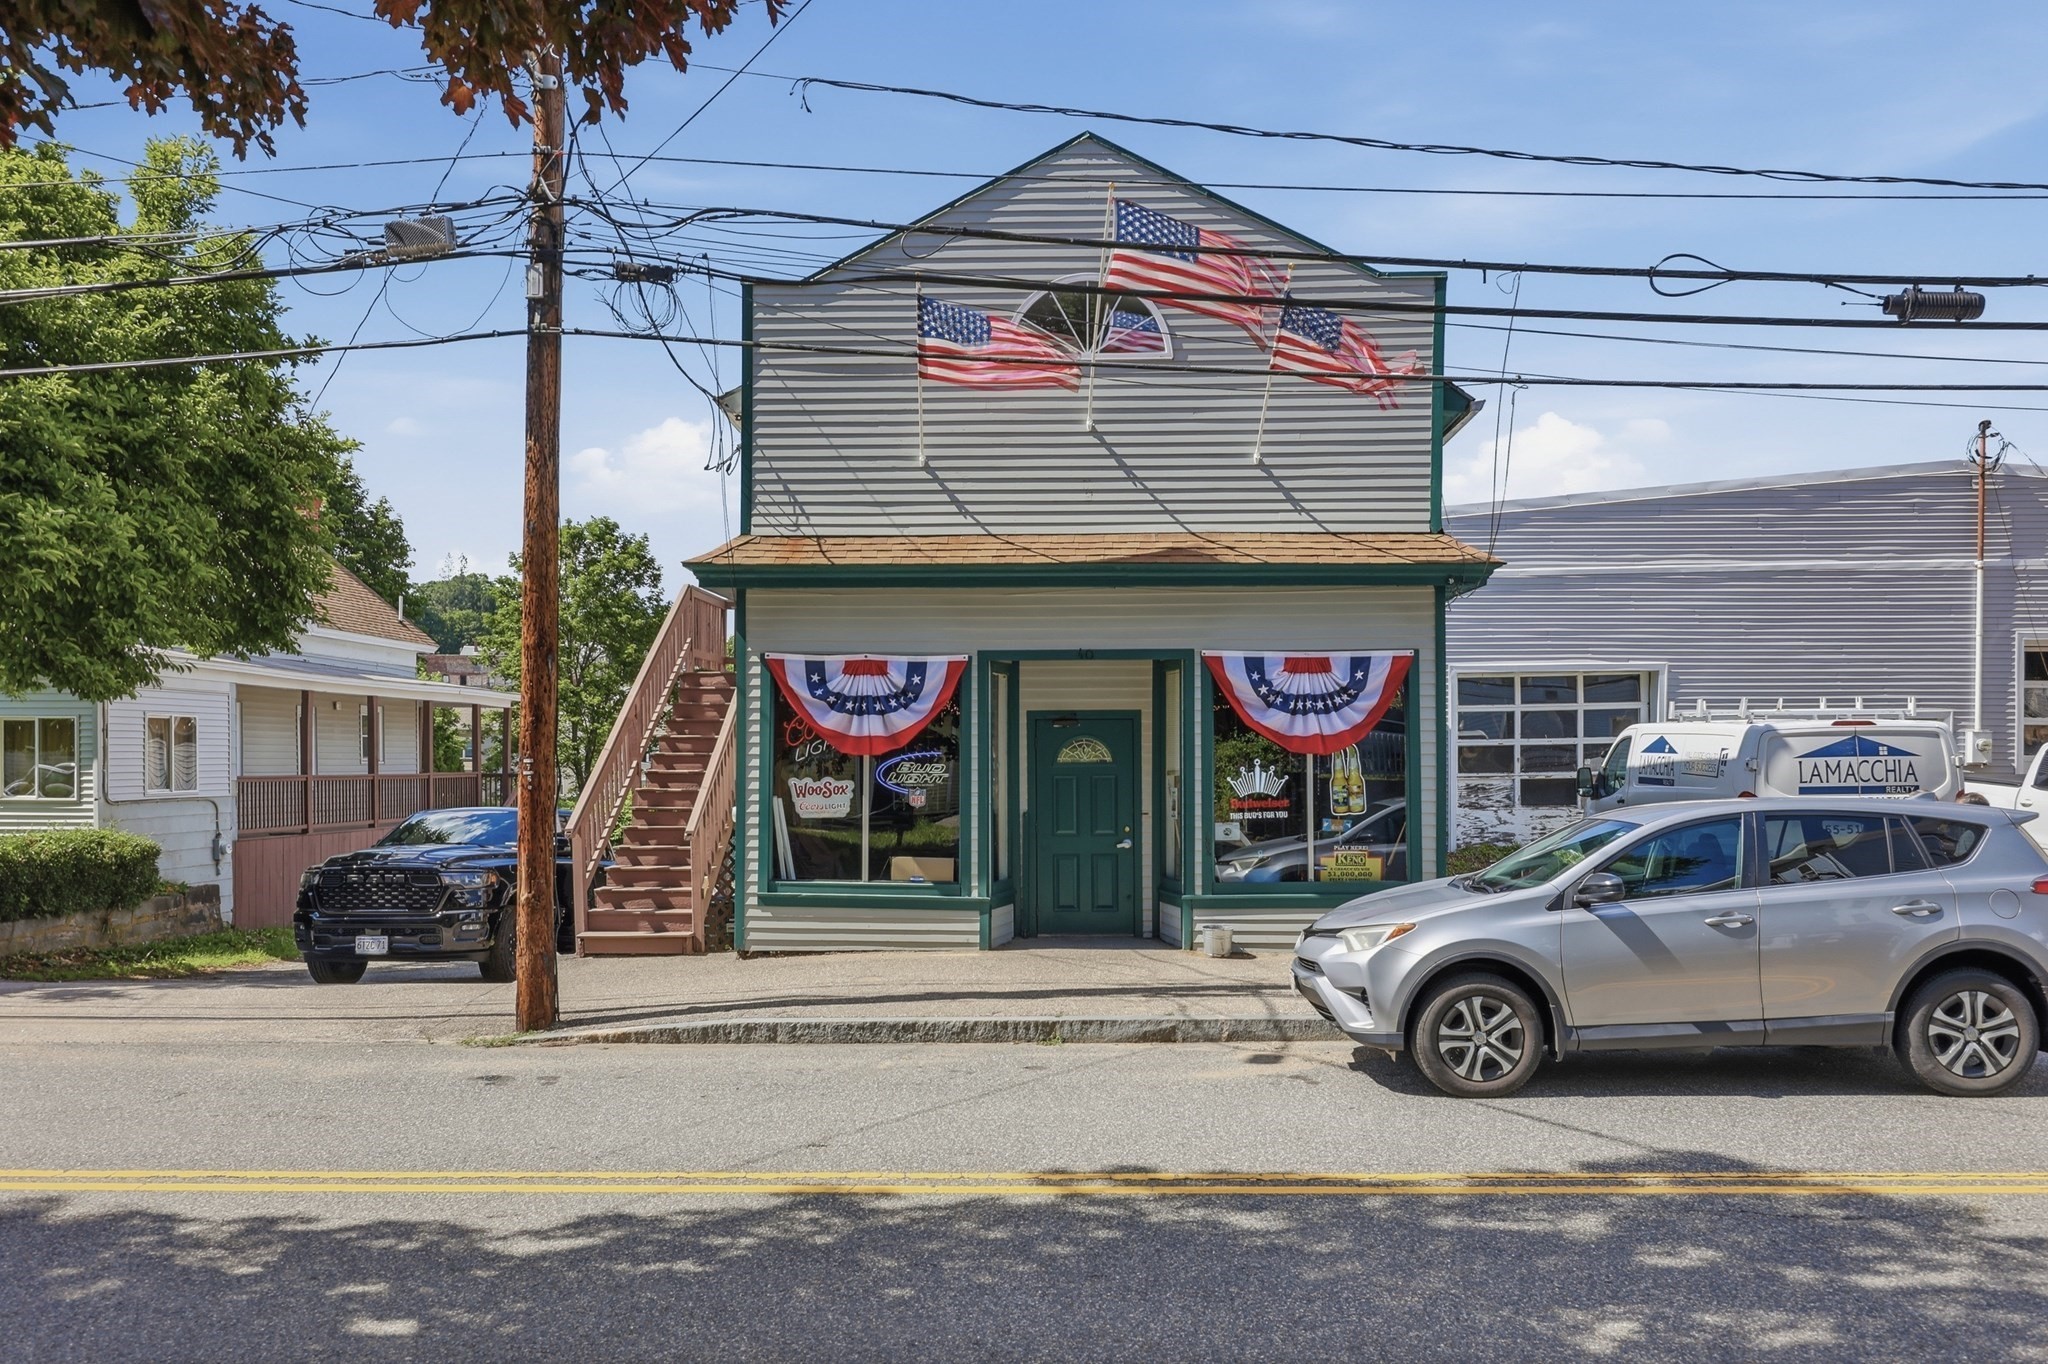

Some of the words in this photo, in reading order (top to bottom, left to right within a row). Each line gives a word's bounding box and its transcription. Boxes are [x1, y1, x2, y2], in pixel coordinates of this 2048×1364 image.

[795, 739, 835, 762] LIG
[896, 761, 947, 774] BUD
[1639, 755, 1675, 777] LAMACCHIA
[1798, 759, 1919, 784] LAMACCHIA
[885, 771, 950, 784] LIGHT
[793, 781, 849, 799] WooSox
[1886, 786, 1915, 794] REALTY
[799, 801, 824, 810] Coors
[911, 796, 924, 804] NFL
[1230, 798, 1290, 808] Budweiser
[1230, 812, 1243, 820] THIS
[1244, 811, 1262, 819] BUD'S
[1263, 811, 1275, 819] FOR
